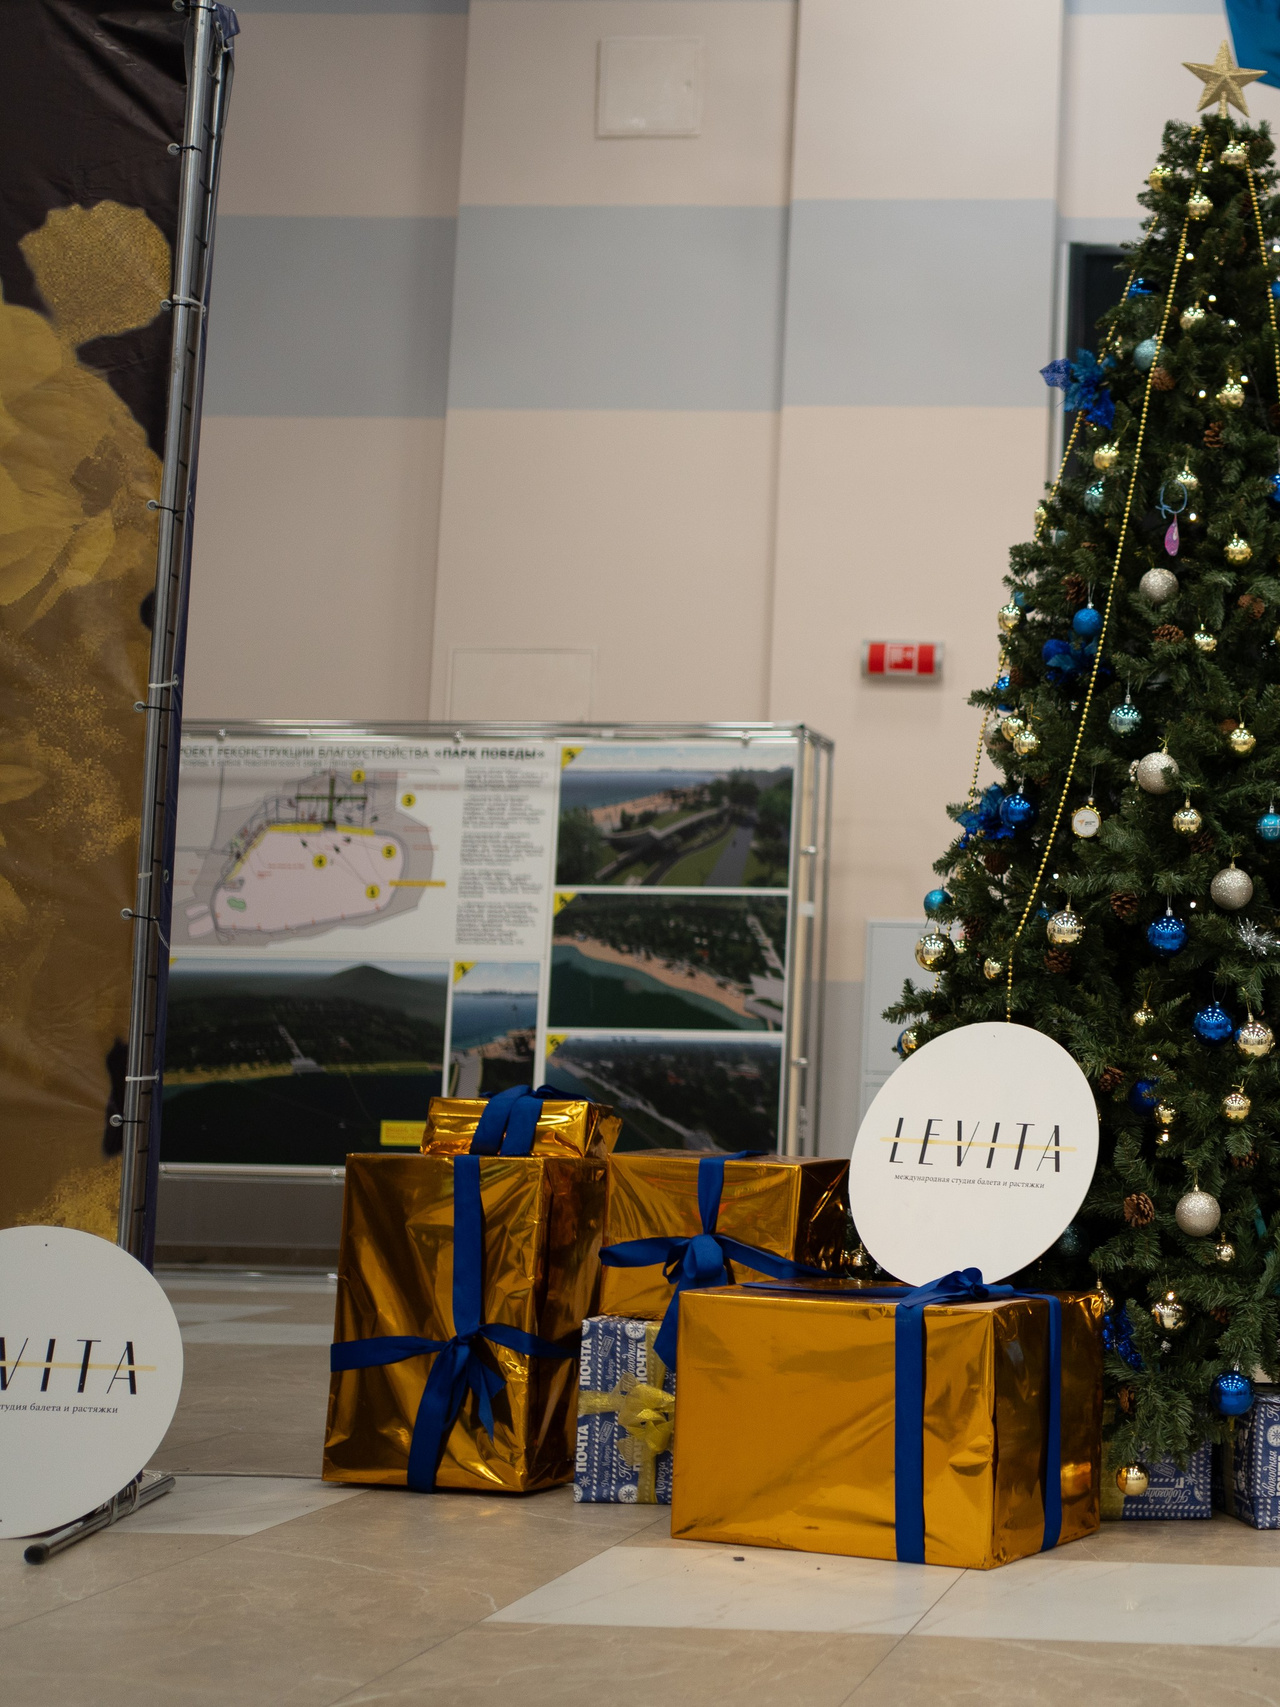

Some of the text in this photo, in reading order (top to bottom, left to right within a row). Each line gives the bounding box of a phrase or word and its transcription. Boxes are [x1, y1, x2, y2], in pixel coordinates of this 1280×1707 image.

[318, 745, 430, 761] БЛАГОУСТРОЙСТВА
[889, 1117, 1061, 1173] LEVITA
[894, 1174, 951, 1184] международная
[951, 1177, 976, 1186] студия
[977, 1177, 1001, 1186] балета
[1009, 1181, 1046, 1189] растяжки
[0, 1336, 137, 1395] VITA
[579, 1338, 592, 1386] ПОЧТА
[0, 1403, 27, 1412] тудия
[30, 1402, 61, 1412] балета
[72, 1406, 119, 1415] растяжки
[575, 1424, 589, 1473] ПОЧТА
[1139, 1488, 1191, 1504] Новогодн
[1262, 1450, 1278, 1498] овогодняя
